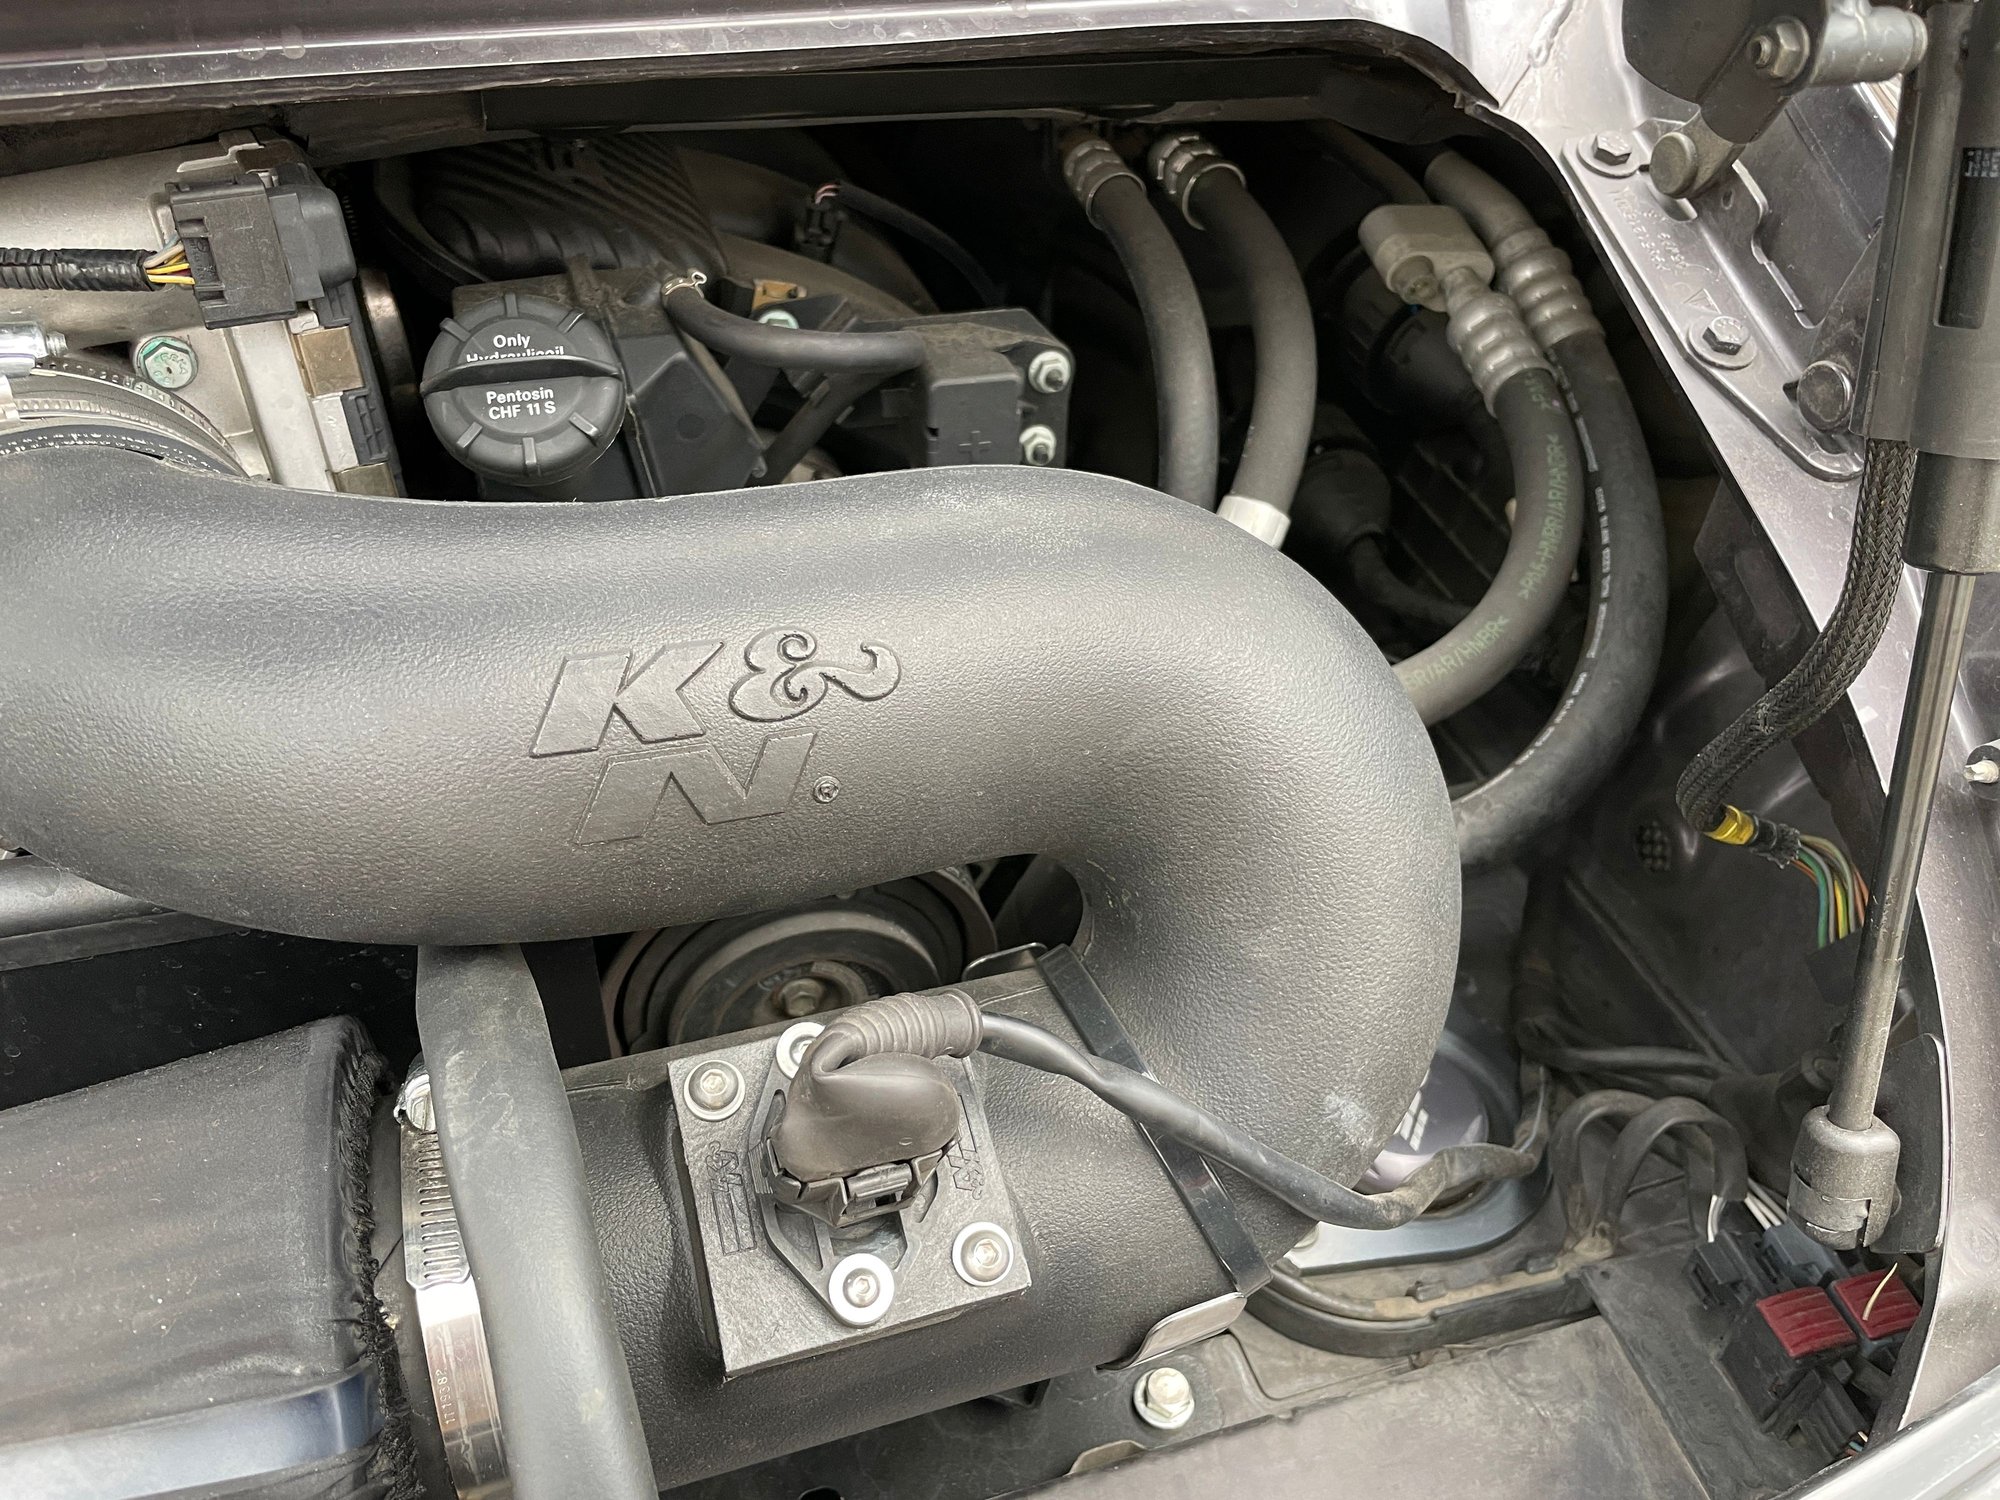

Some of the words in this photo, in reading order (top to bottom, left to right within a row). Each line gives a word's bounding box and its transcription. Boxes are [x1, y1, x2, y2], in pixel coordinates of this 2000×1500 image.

[493, 333, 531, 348] Only
[486, 387, 554, 404] Pentosin
[488, 404, 521, 420] CHF
[527, 403, 541, 416] 11
[544, 401, 557, 414] S
